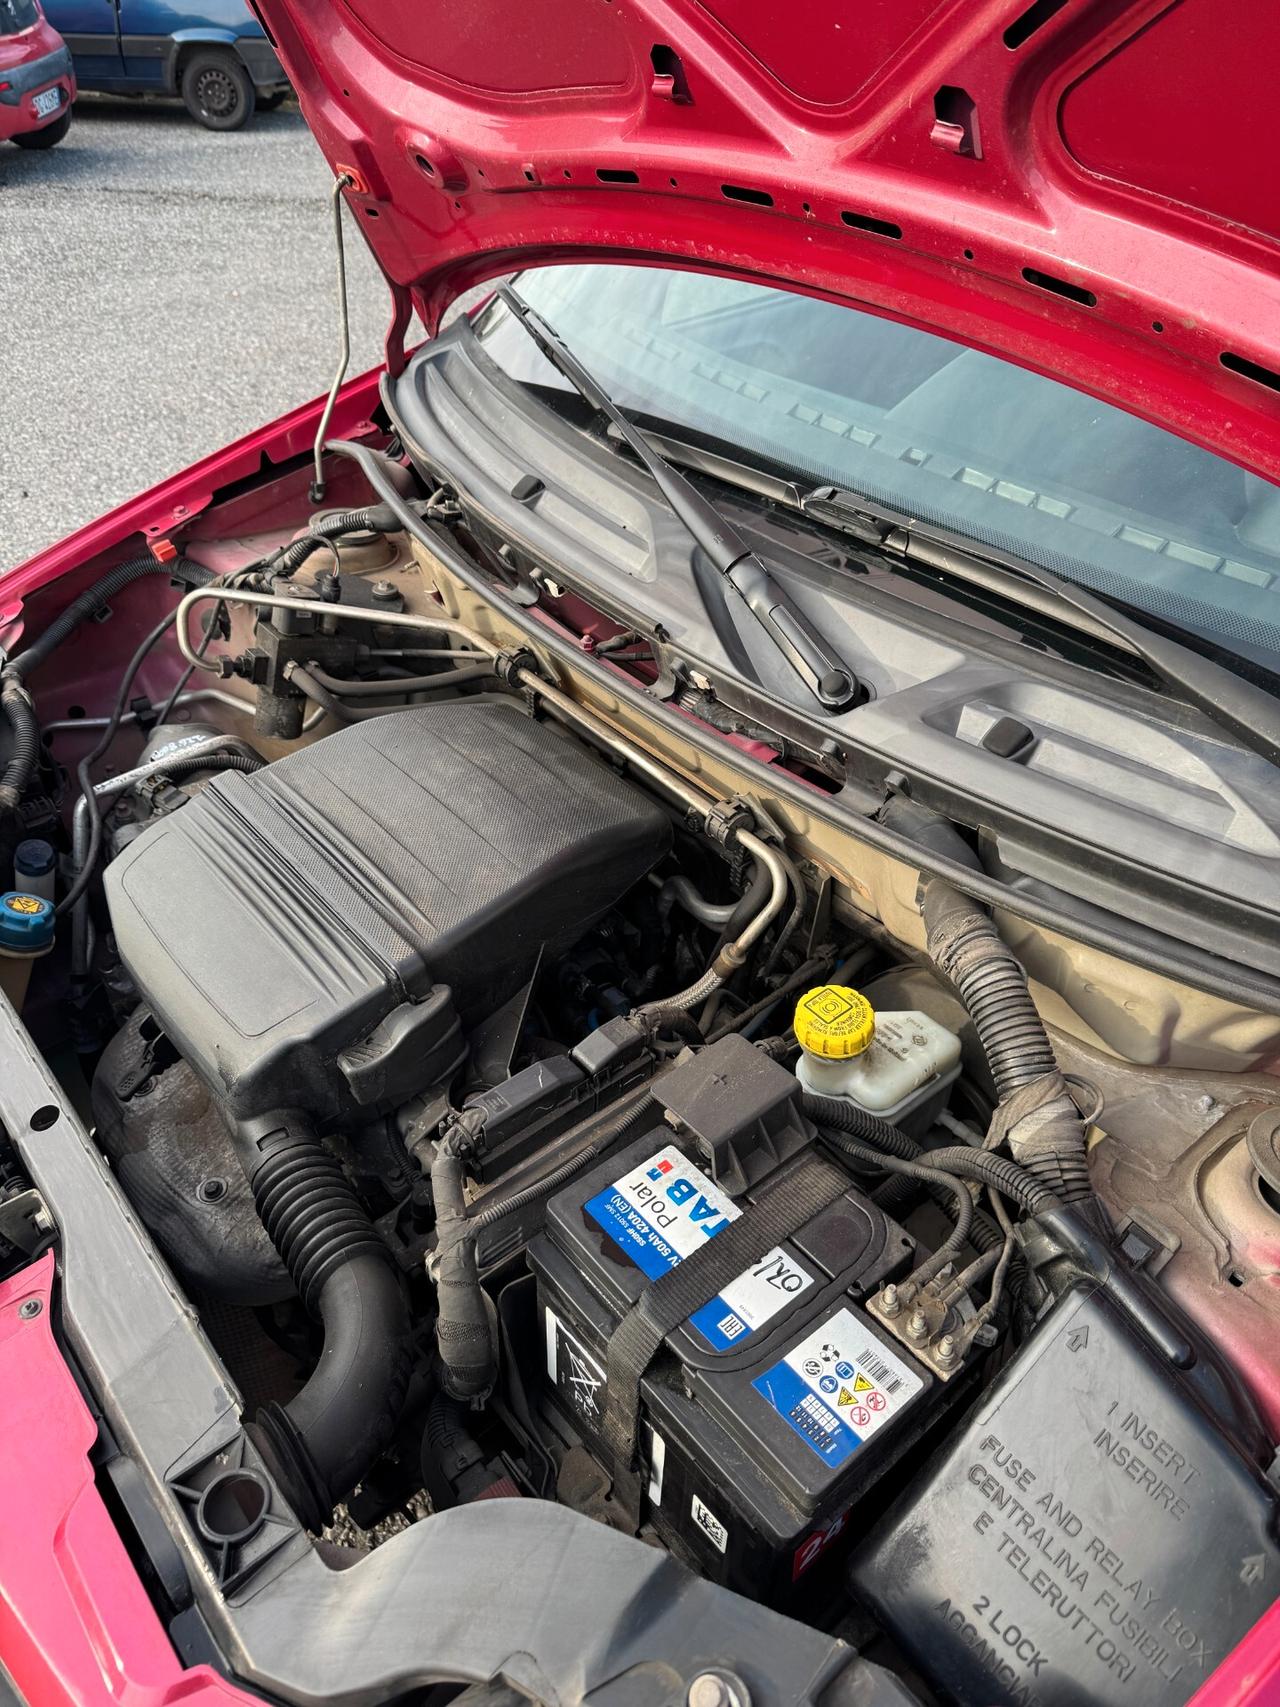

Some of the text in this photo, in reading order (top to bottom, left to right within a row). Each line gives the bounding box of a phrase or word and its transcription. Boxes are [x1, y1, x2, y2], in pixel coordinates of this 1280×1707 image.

[610, 1194, 632, 1214] (EN)
[628, 1210, 650, 1234] 420A
[629, 1182, 678, 1228] Polar
[648, 1232, 672, 1256] 50Ah
[666, 1178, 732, 1238] TAB
[1093, 1427, 1190, 1522] INSERIRE
[1106, 1400, 1200, 1486] 1 INSERT
[968, 1462, 1184, 1683] CENTRALINA FUSIBILI
[980, 1435, 1216, 1669] FUSE AND RELAY BOX
[973, 1510, 1137, 1683] E TELERUTTORI
[974, 1594, 1048, 1678] 2 LOCK
